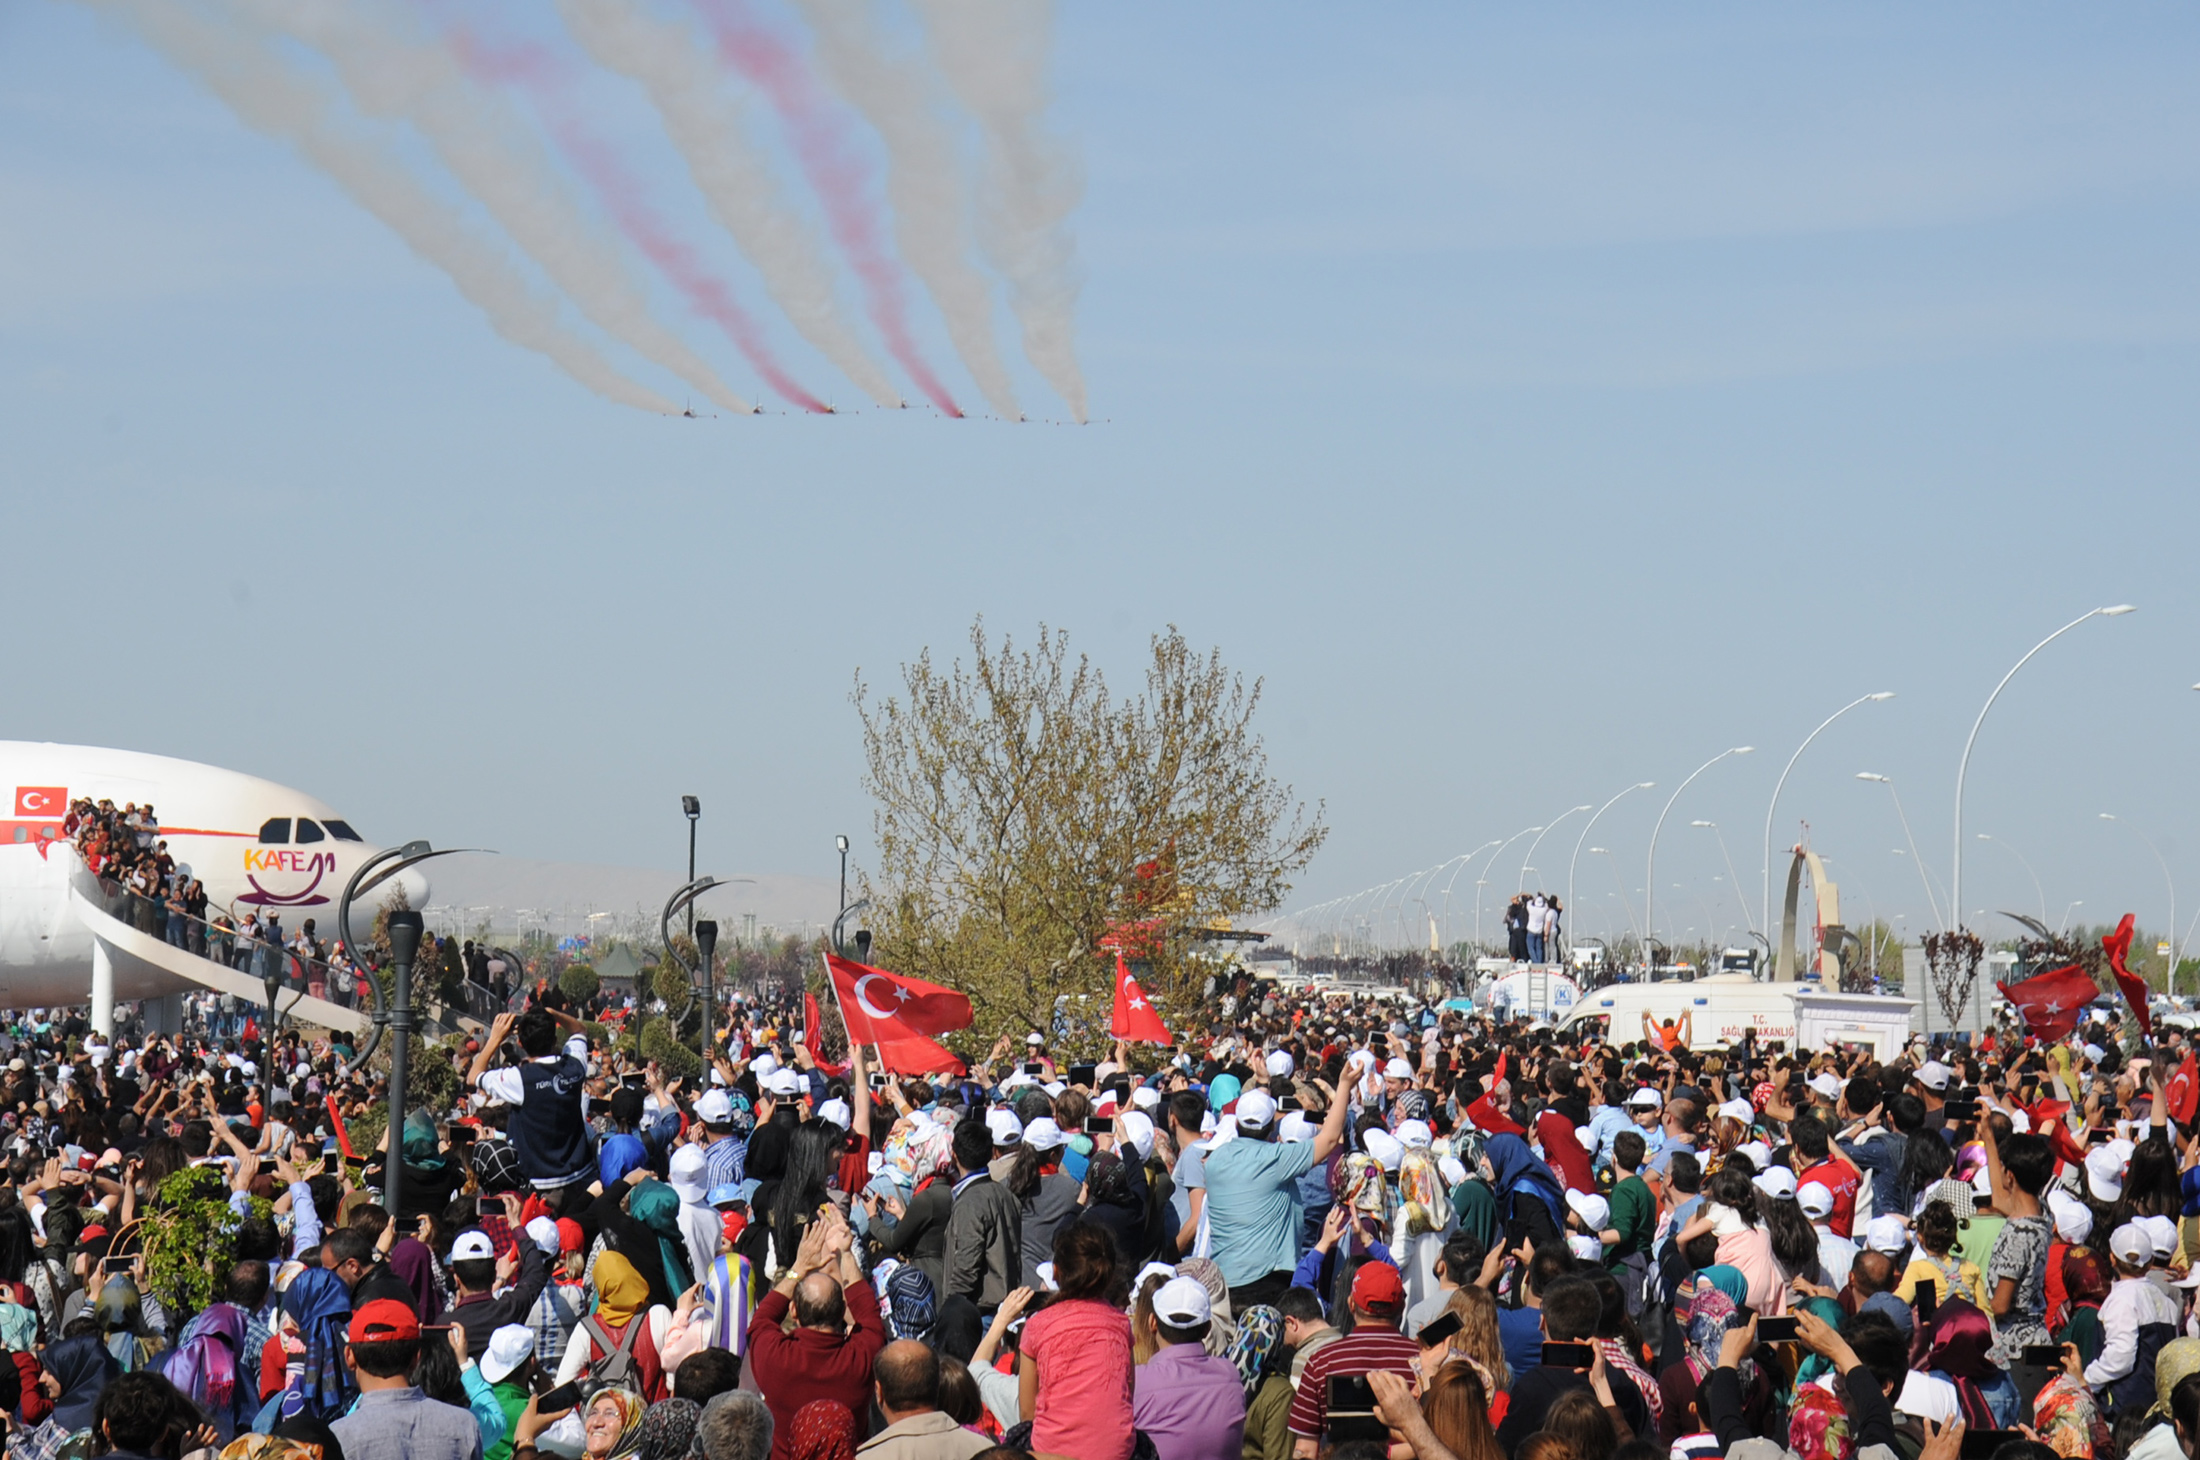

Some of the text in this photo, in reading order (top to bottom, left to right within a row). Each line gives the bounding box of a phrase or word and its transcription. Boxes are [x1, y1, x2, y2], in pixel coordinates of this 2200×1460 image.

[244, 849, 335, 872] KAFEM
[1752, 1014, 1767, 1025] T.C.
[1721, 1024, 1795, 1037] SAĞLI AKANLIĞ
